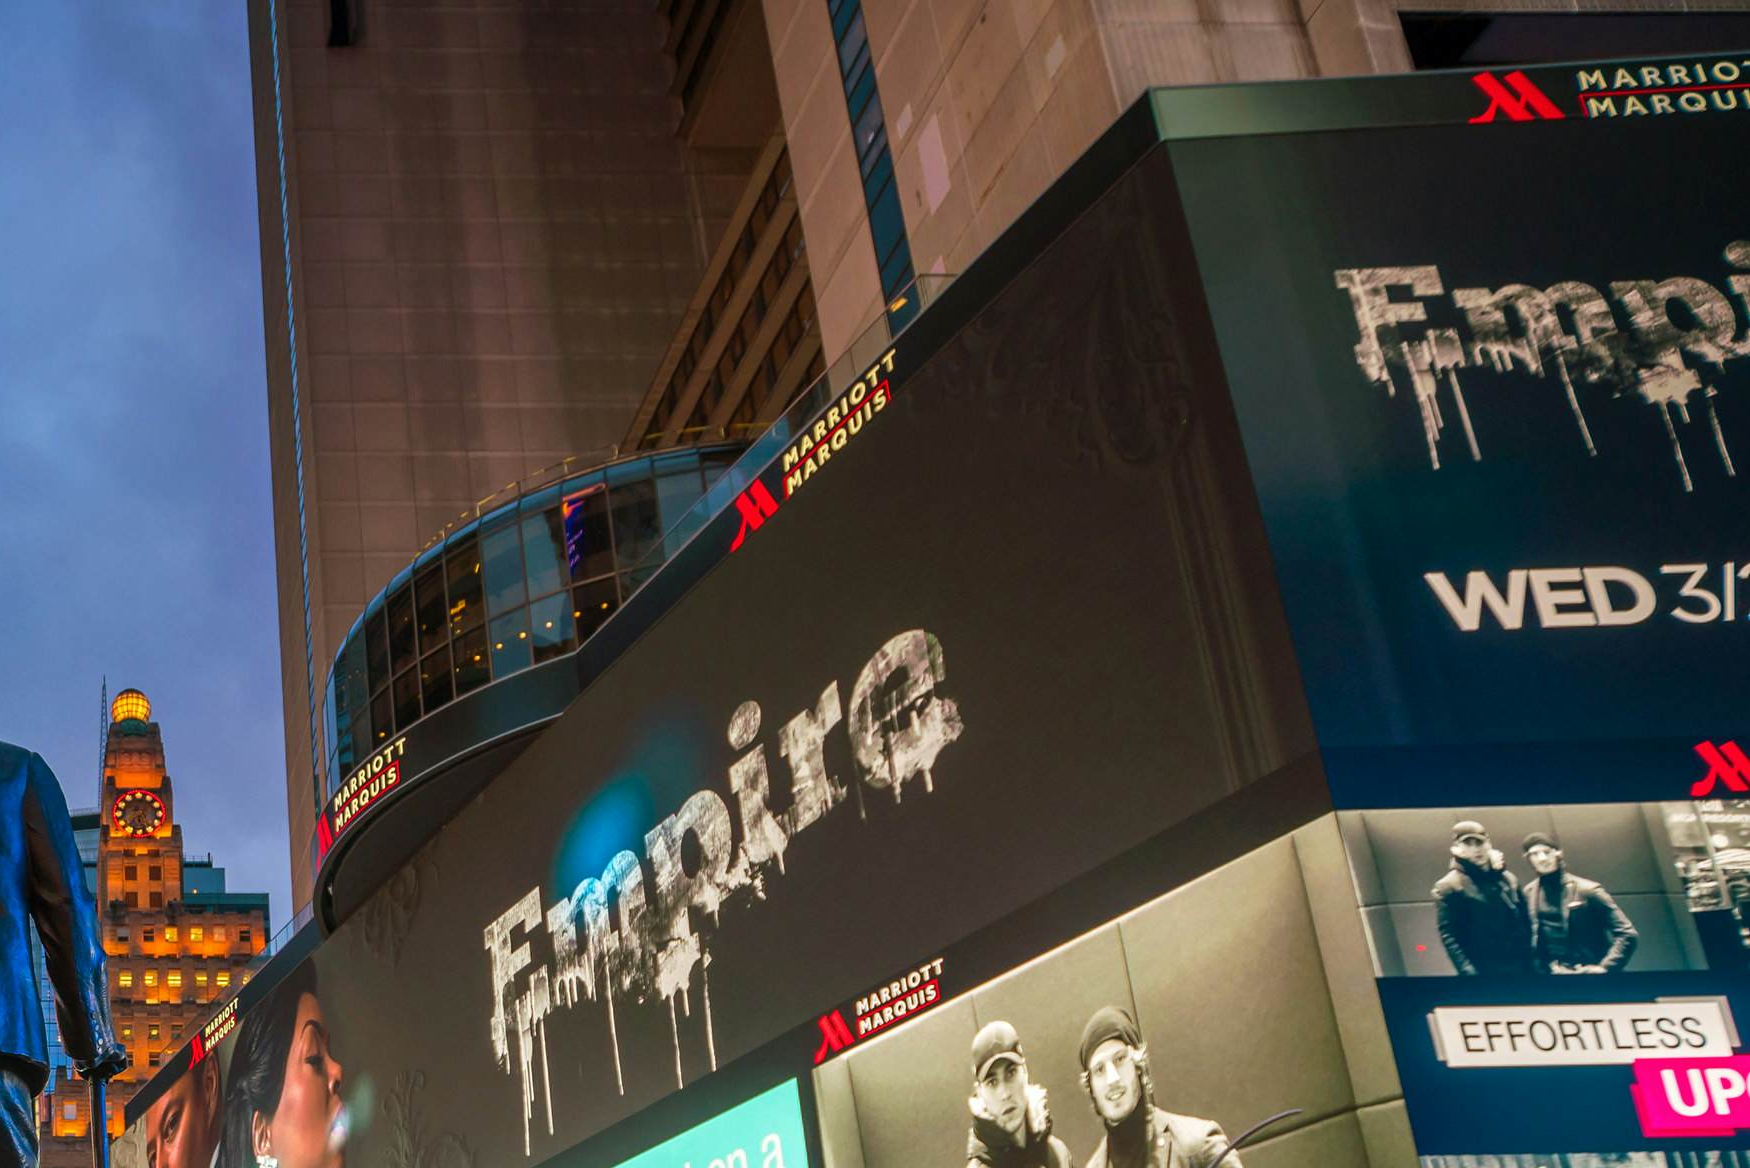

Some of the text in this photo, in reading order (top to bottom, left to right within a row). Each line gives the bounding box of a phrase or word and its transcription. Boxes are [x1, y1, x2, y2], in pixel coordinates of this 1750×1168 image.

[782, 348, 898, 471] MARRIOTT
[784, 387, 889, 495] MARQUIS
[1424, 565, 1657, 632] WED
[333, 737, 408, 811] MARRIOTT
[334, 766, 399, 834] MARQUIS
[484, 628, 965, 1085] Empire
[205, 997, 240, 1038] MARRIOTT
[855, 956, 945, 1016] MARRIOTT
[858, 981, 939, 1036] MARQUIS
[205, 1015, 237, 1053] MARQUIS
[1459, 1016, 1708, 1053] EFFORTLESS
[1660, 1067, 1750, 1119] UP
